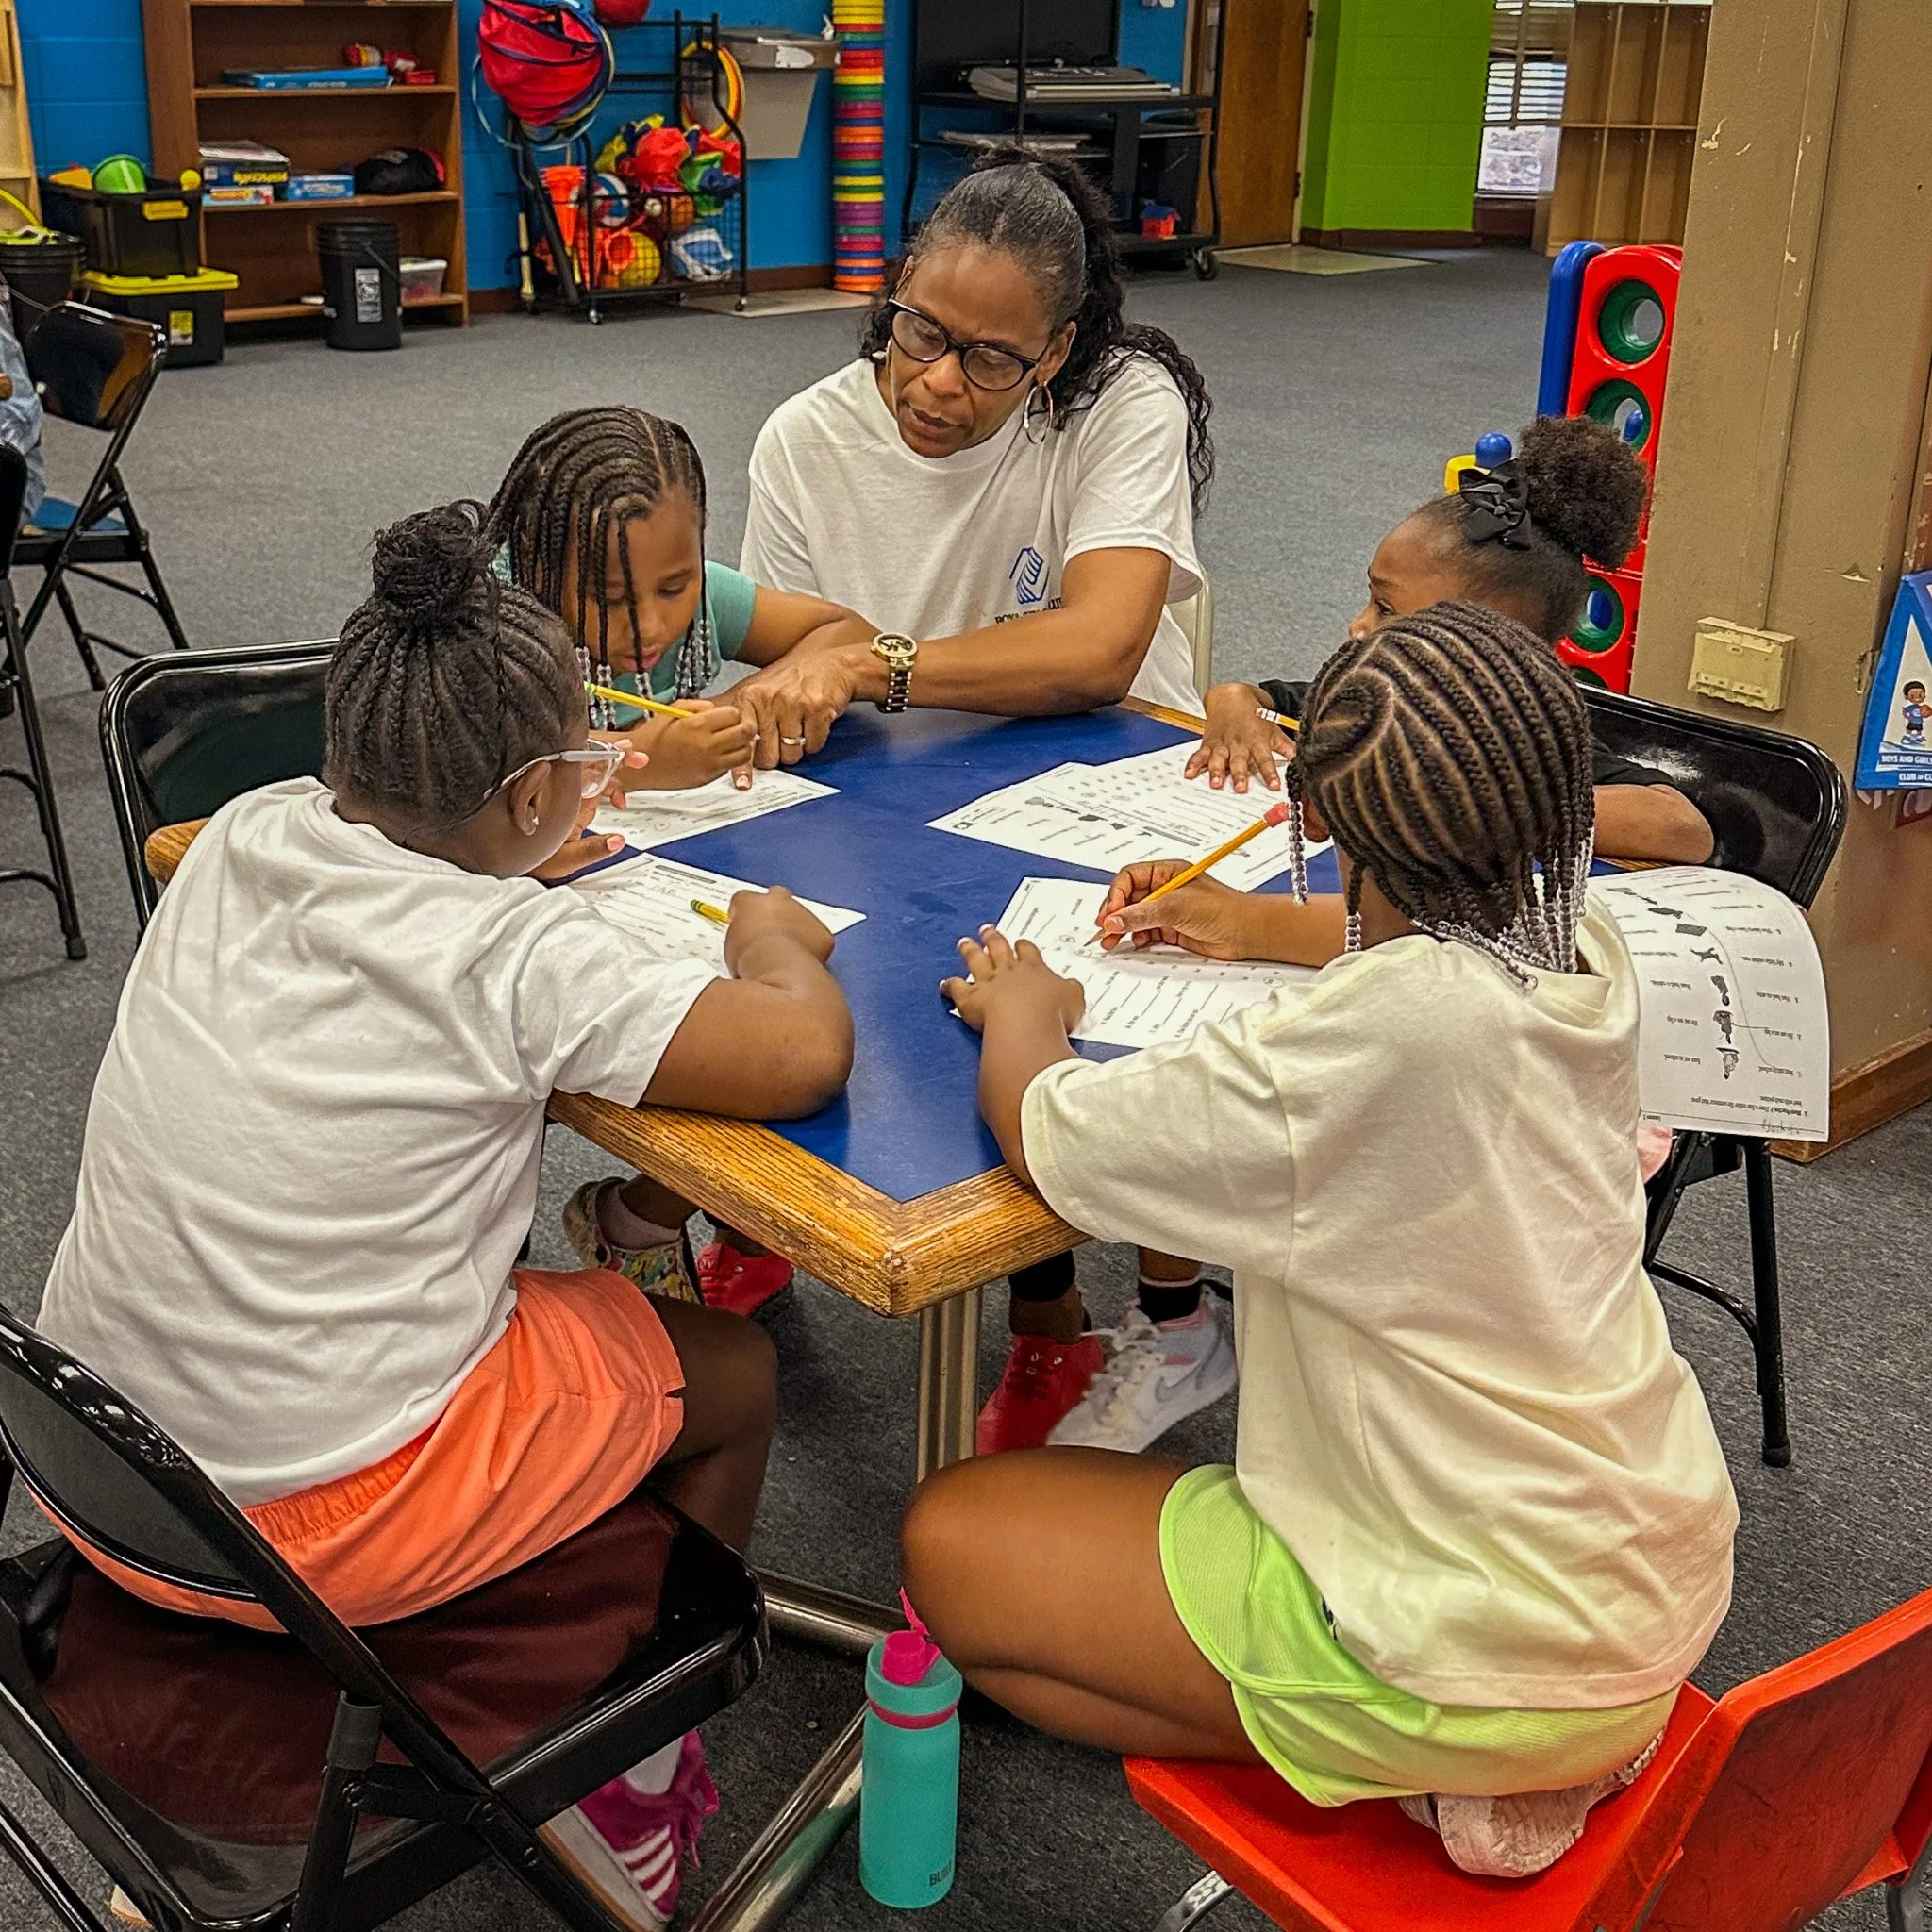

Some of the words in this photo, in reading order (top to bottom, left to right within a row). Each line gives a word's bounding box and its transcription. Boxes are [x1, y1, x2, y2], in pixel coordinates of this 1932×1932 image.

[1881, 755, 1898, 763] BOYS
[1899, 755, 1913, 763] AND
[1898, 773, 1917, 781] CLUB
